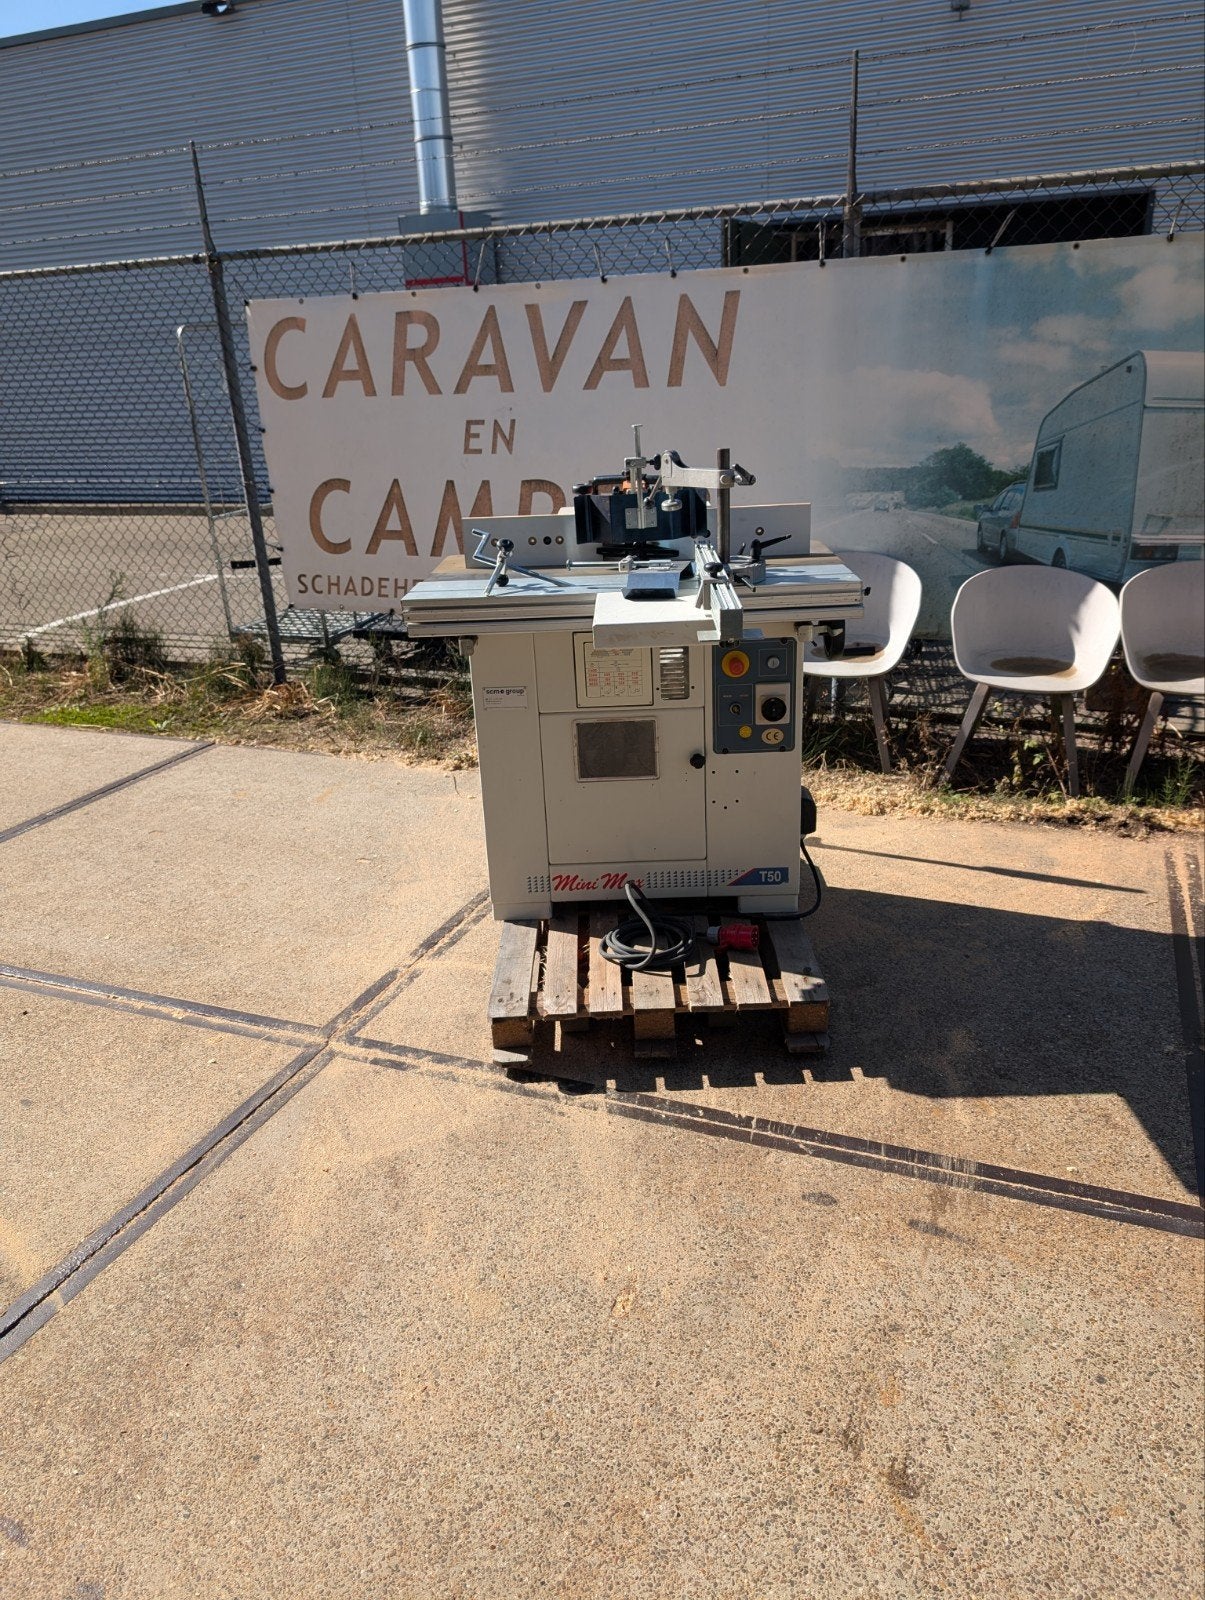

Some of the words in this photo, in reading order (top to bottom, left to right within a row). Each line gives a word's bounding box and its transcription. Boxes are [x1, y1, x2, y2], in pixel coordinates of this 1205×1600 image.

[264, 290, 741, 401] CARAVAN
[463, 418, 516, 455] EN
[297, 573, 425, 598] SCHADEH
[759, 871, 781, 882] T50
